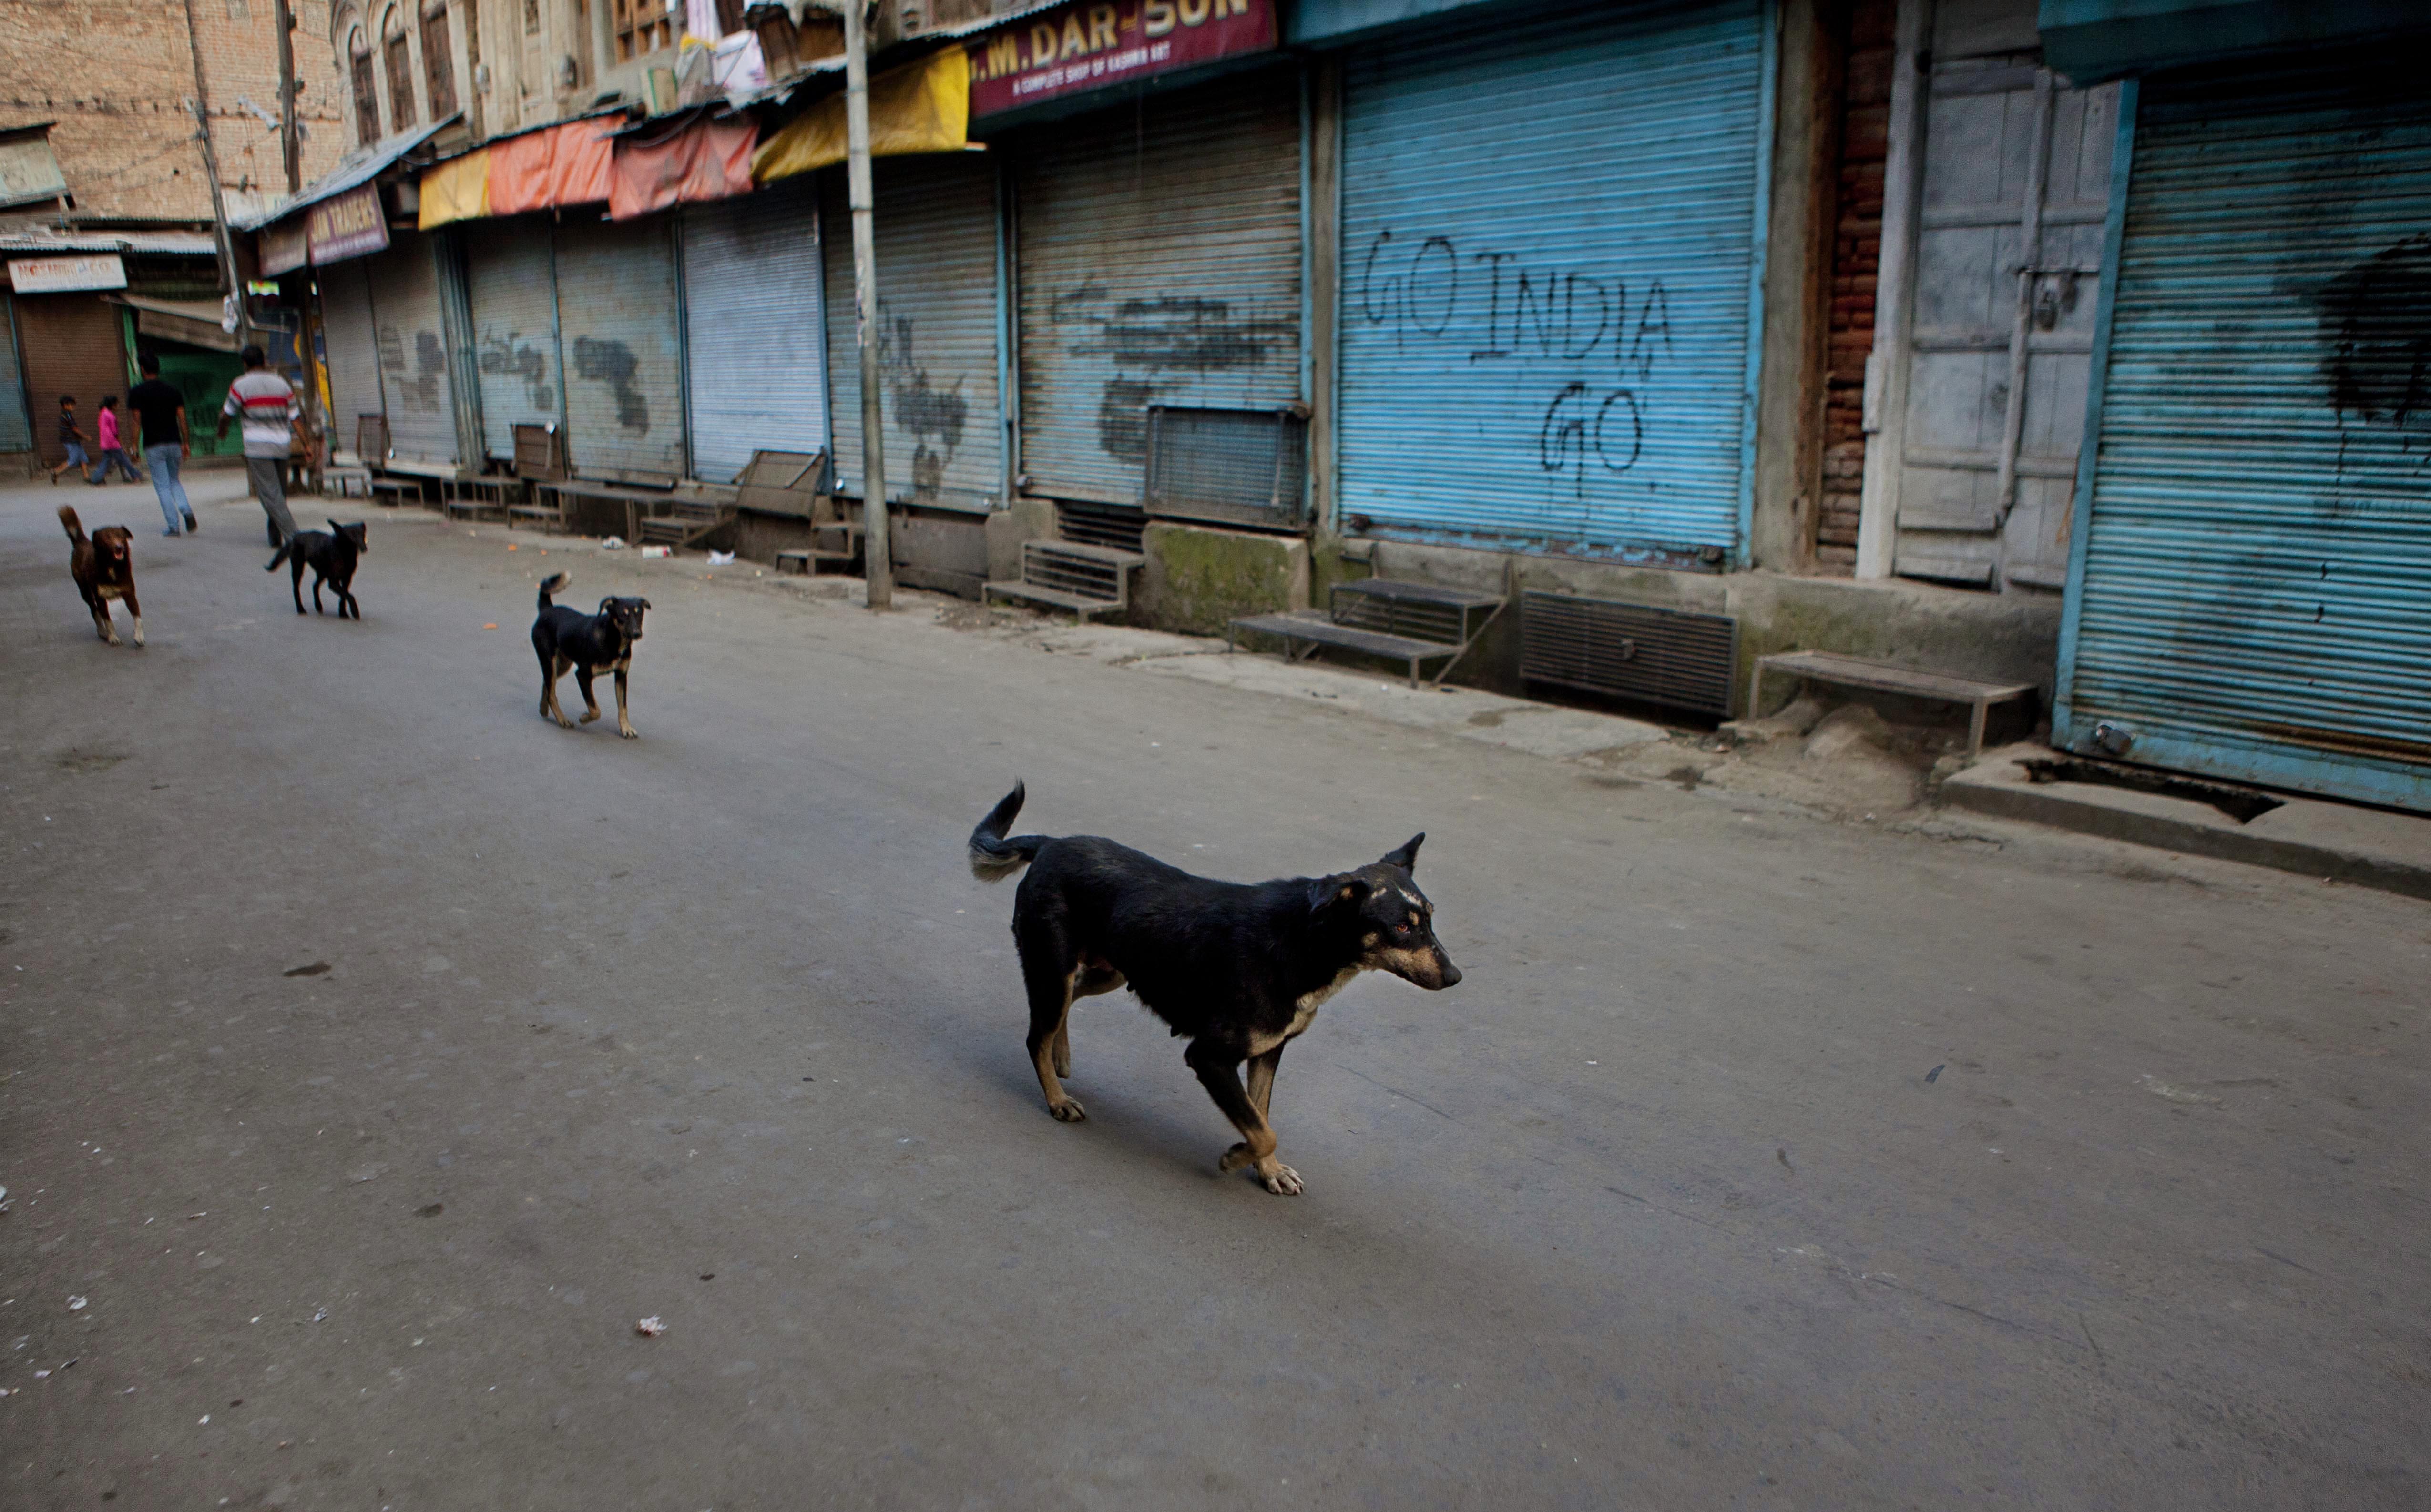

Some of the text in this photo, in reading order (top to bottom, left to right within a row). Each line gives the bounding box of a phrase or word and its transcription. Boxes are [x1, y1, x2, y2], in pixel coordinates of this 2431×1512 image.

[1092, 57, 1105, 77] OF
[1364, 231, 1673, 364] GO INDIA
[1541, 381, 1642, 499] GO
